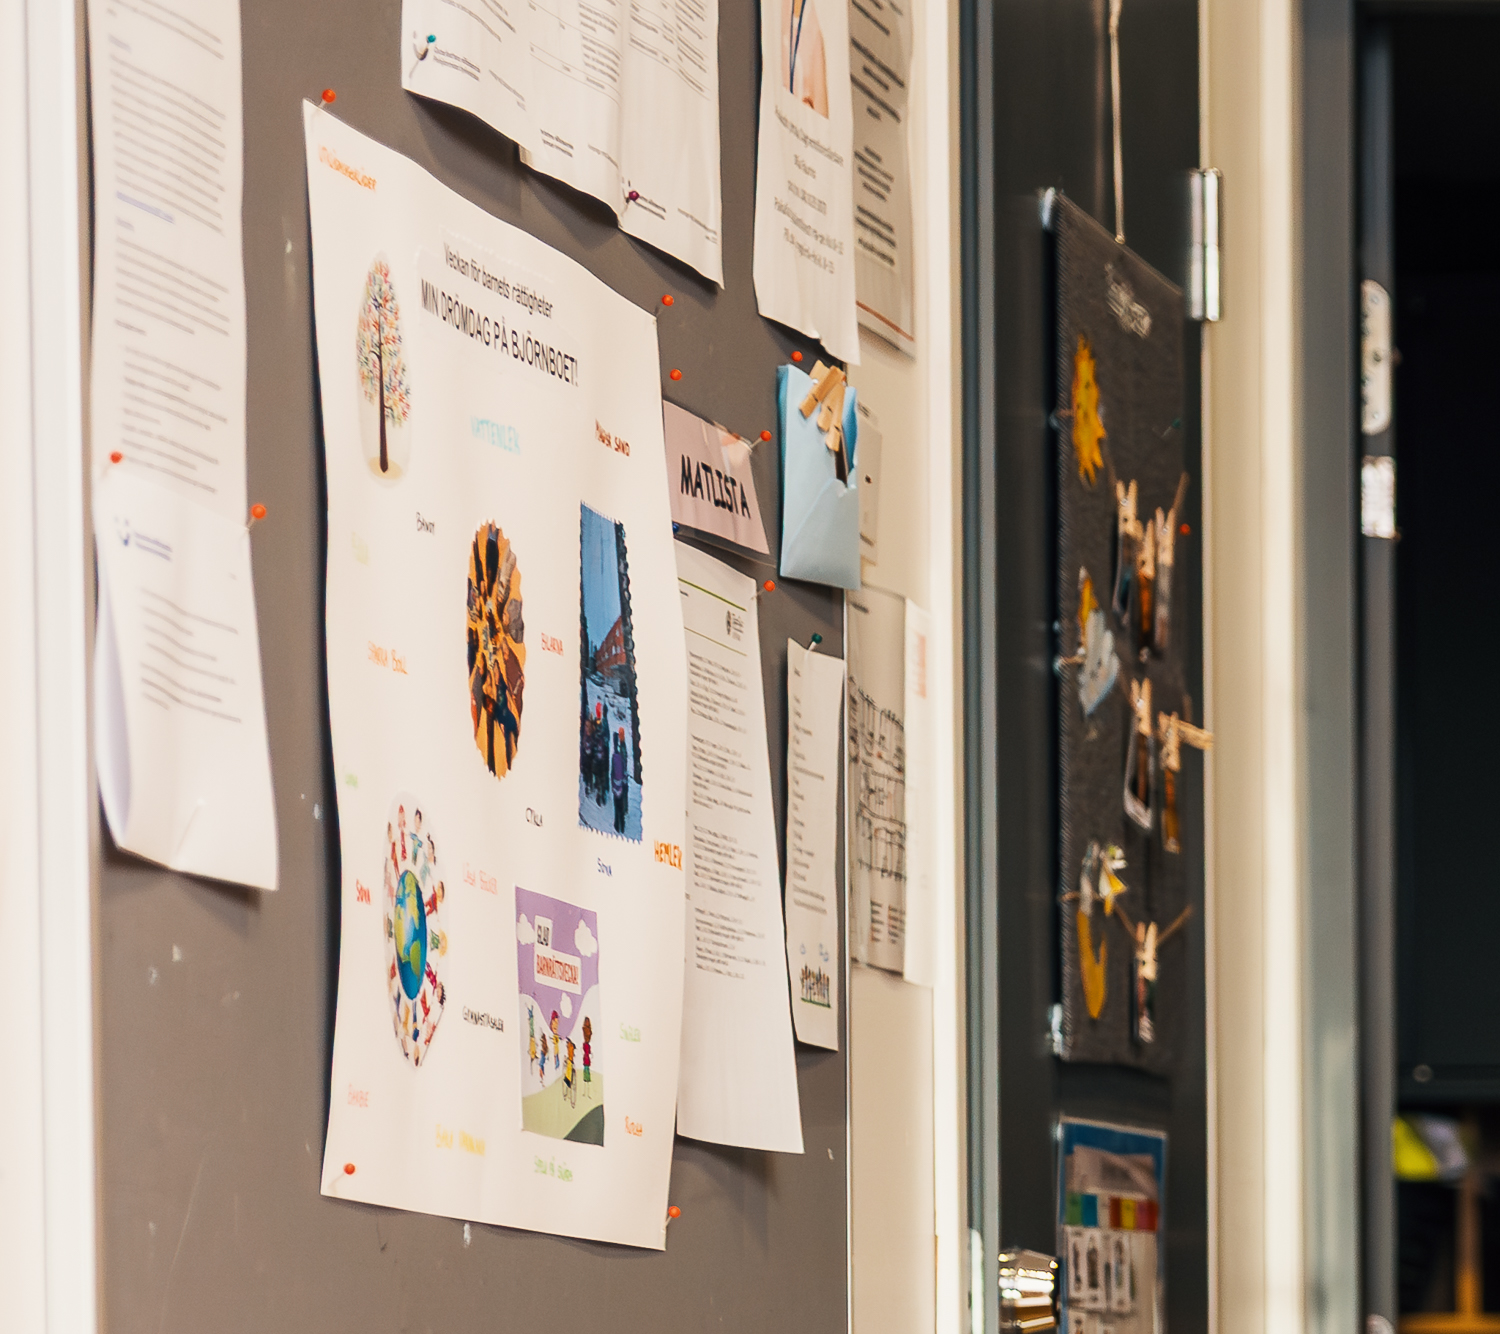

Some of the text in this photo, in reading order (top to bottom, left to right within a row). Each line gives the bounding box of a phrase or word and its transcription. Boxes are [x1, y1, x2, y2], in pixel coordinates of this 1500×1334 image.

[444, 241, 554, 319] Veckan för barnets rättigheter
[421, 278, 579, 387] MIN DRÖMDAG PÅ BJÖRNBOET!
[681, 453, 751, 520] MATLISTA
